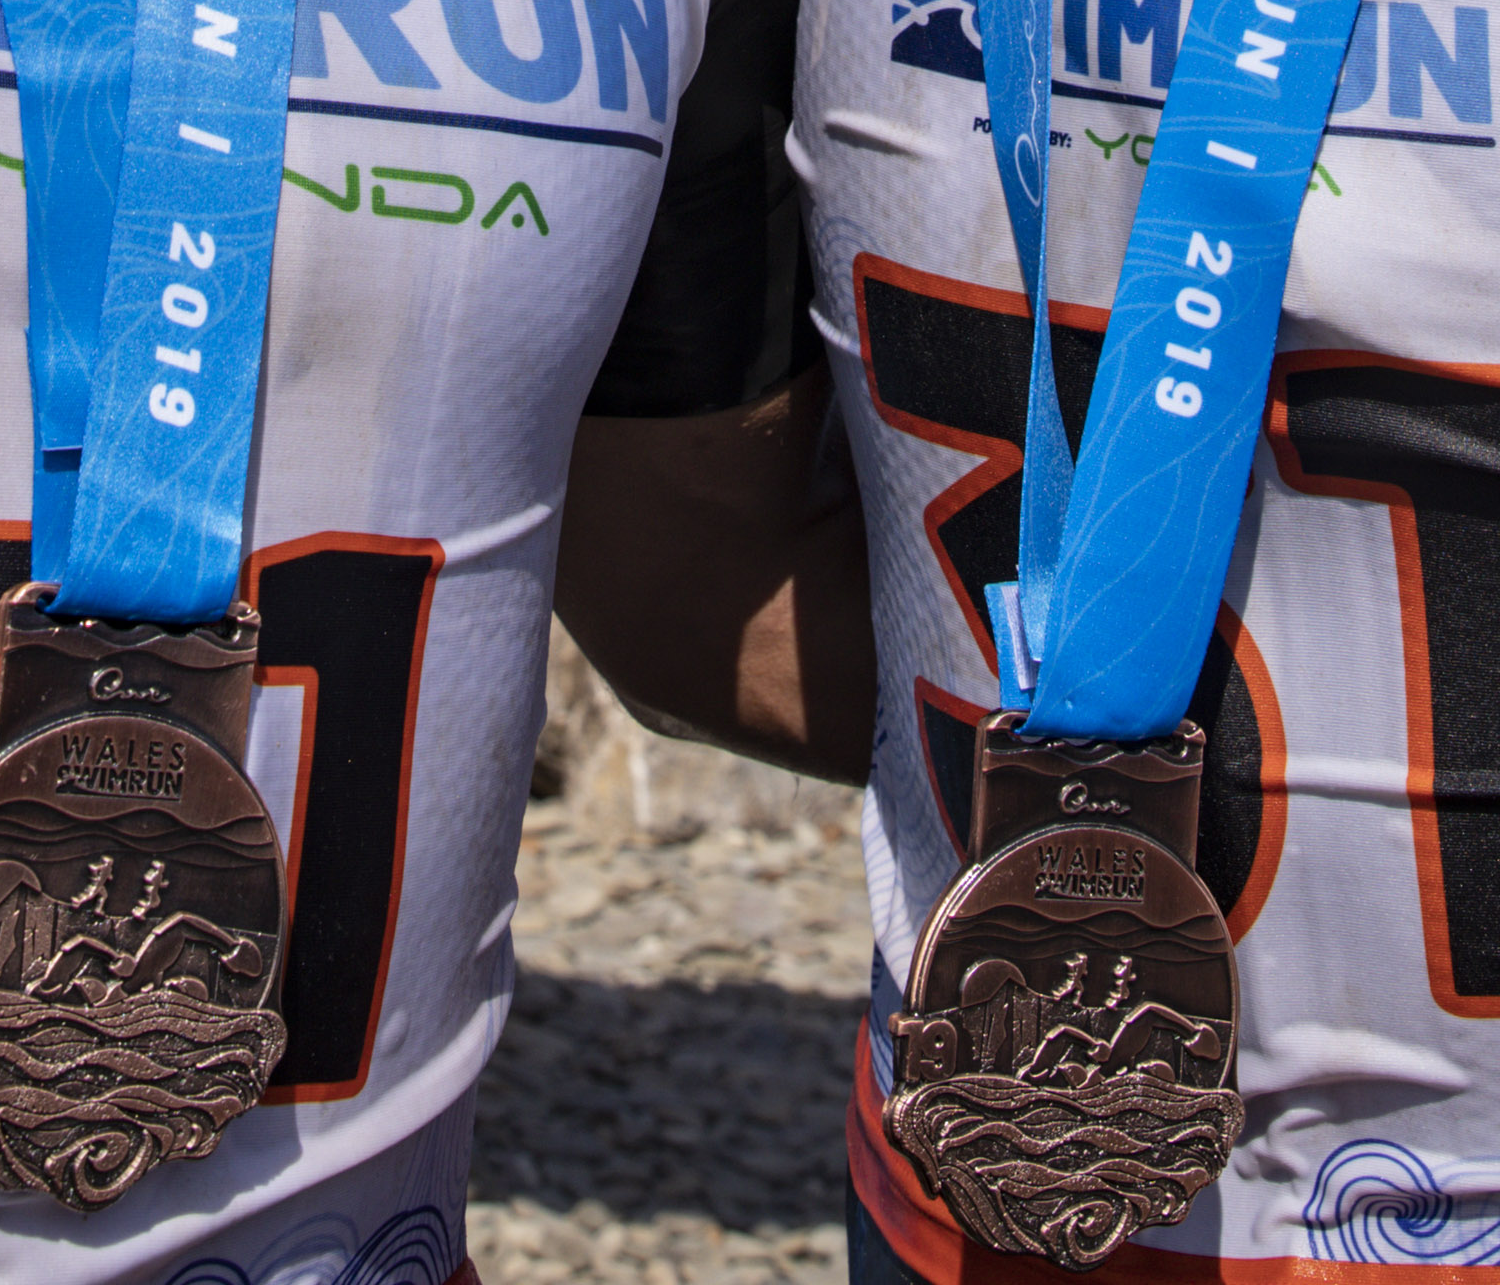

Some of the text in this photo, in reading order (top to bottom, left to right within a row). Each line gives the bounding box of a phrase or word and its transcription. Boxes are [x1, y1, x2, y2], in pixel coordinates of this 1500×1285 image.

[150, 221, 216, 428] 2019
[1155, 231, 1233, 419] 2019
[62, 734, 186, 772] WALES
[55, 764, 184, 798] SWIMRUN
[1037, 845, 1146, 876] WALES
[889, 1017, 958, 1081] 19
